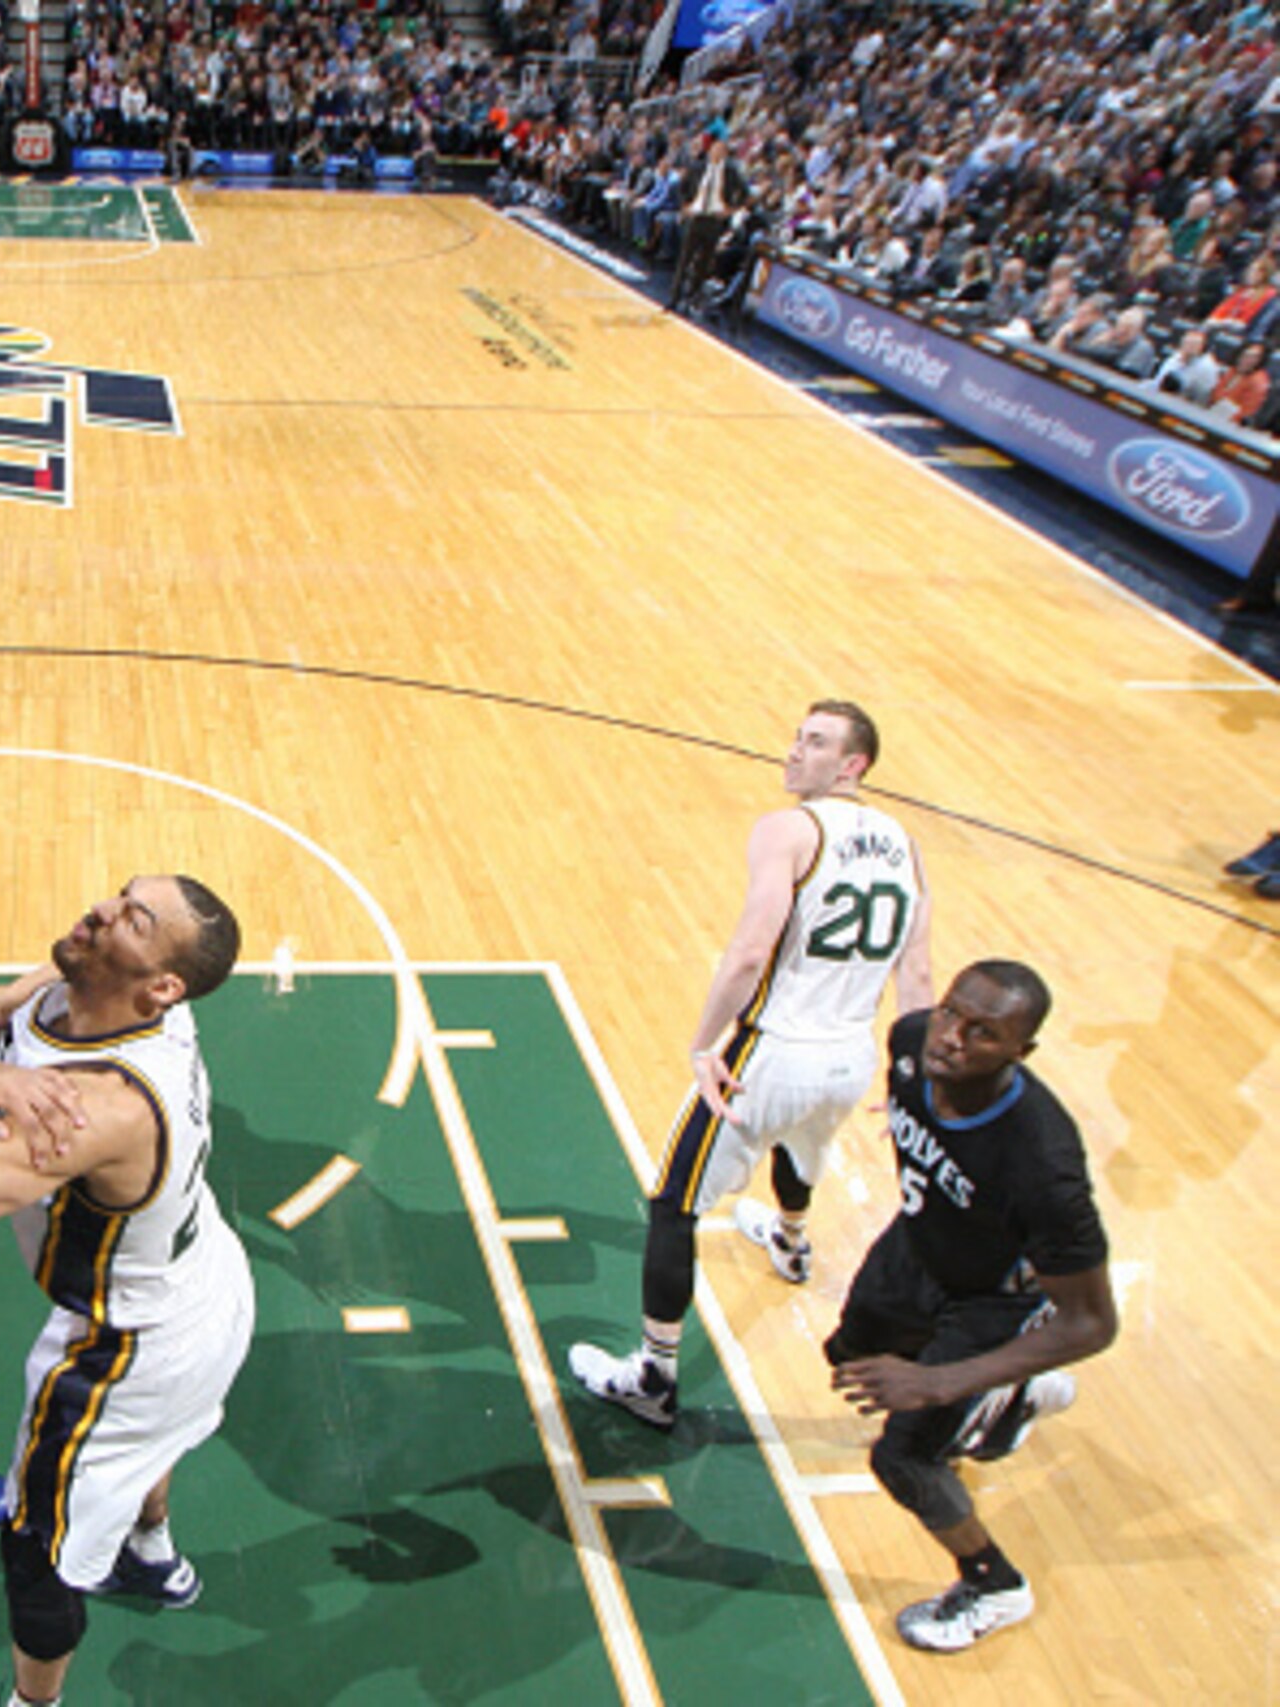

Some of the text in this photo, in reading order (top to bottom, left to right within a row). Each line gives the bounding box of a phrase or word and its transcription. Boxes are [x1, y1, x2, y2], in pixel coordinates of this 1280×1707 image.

[843, 314, 952, 391] Go Further
[1126, 450, 1225, 528] Ford
[806, 881, 910, 963] 20
[901, 1166, 928, 1217] 5
